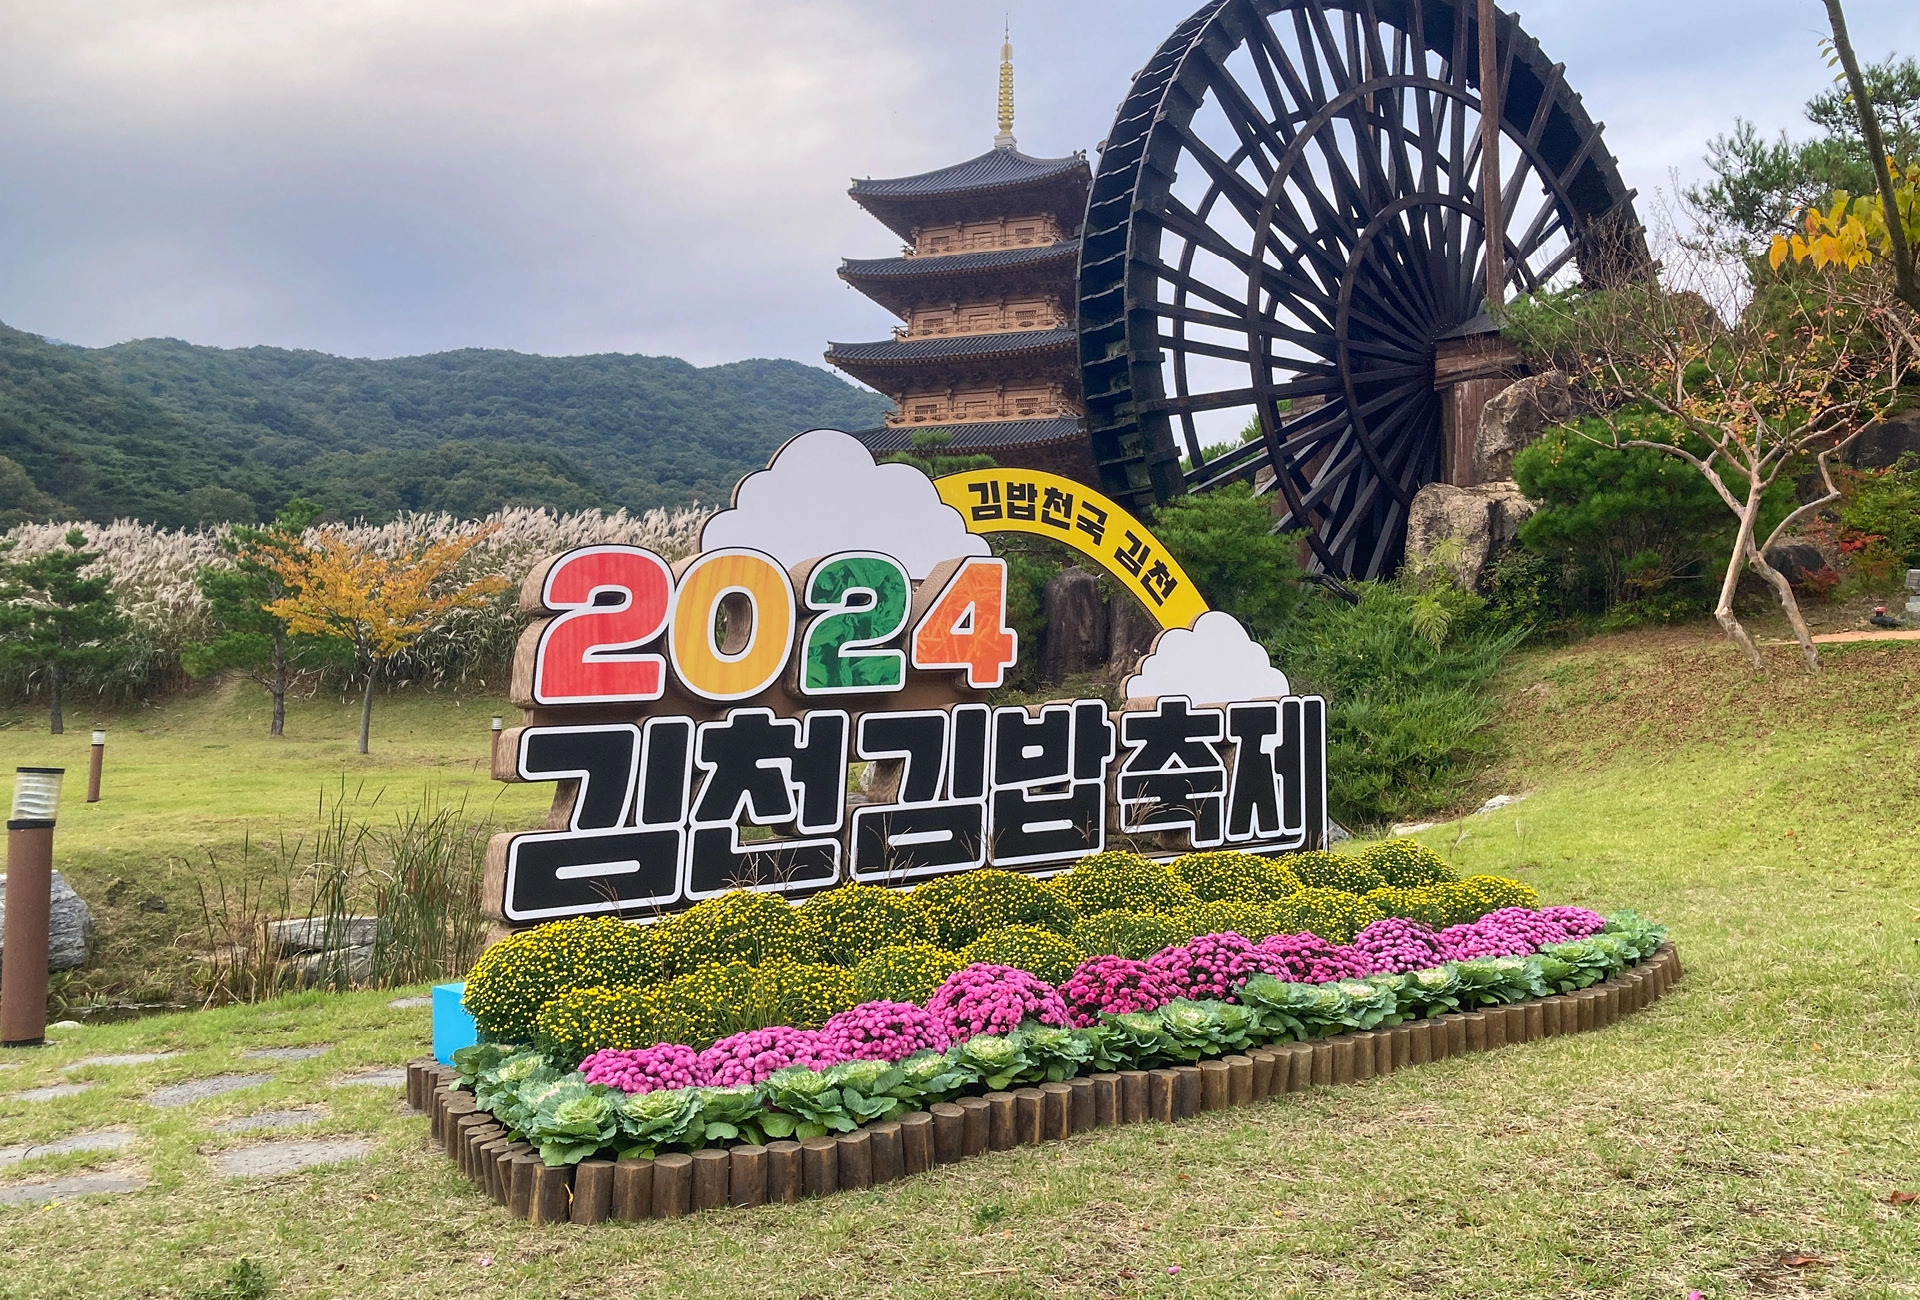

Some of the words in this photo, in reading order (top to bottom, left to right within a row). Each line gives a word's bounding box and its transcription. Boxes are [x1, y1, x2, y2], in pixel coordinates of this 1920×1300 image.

[968, 480, 1109, 547] 김밥천국
[1113, 530, 1178, 607] 김천
[534, 545, 1018, 704] 2024
